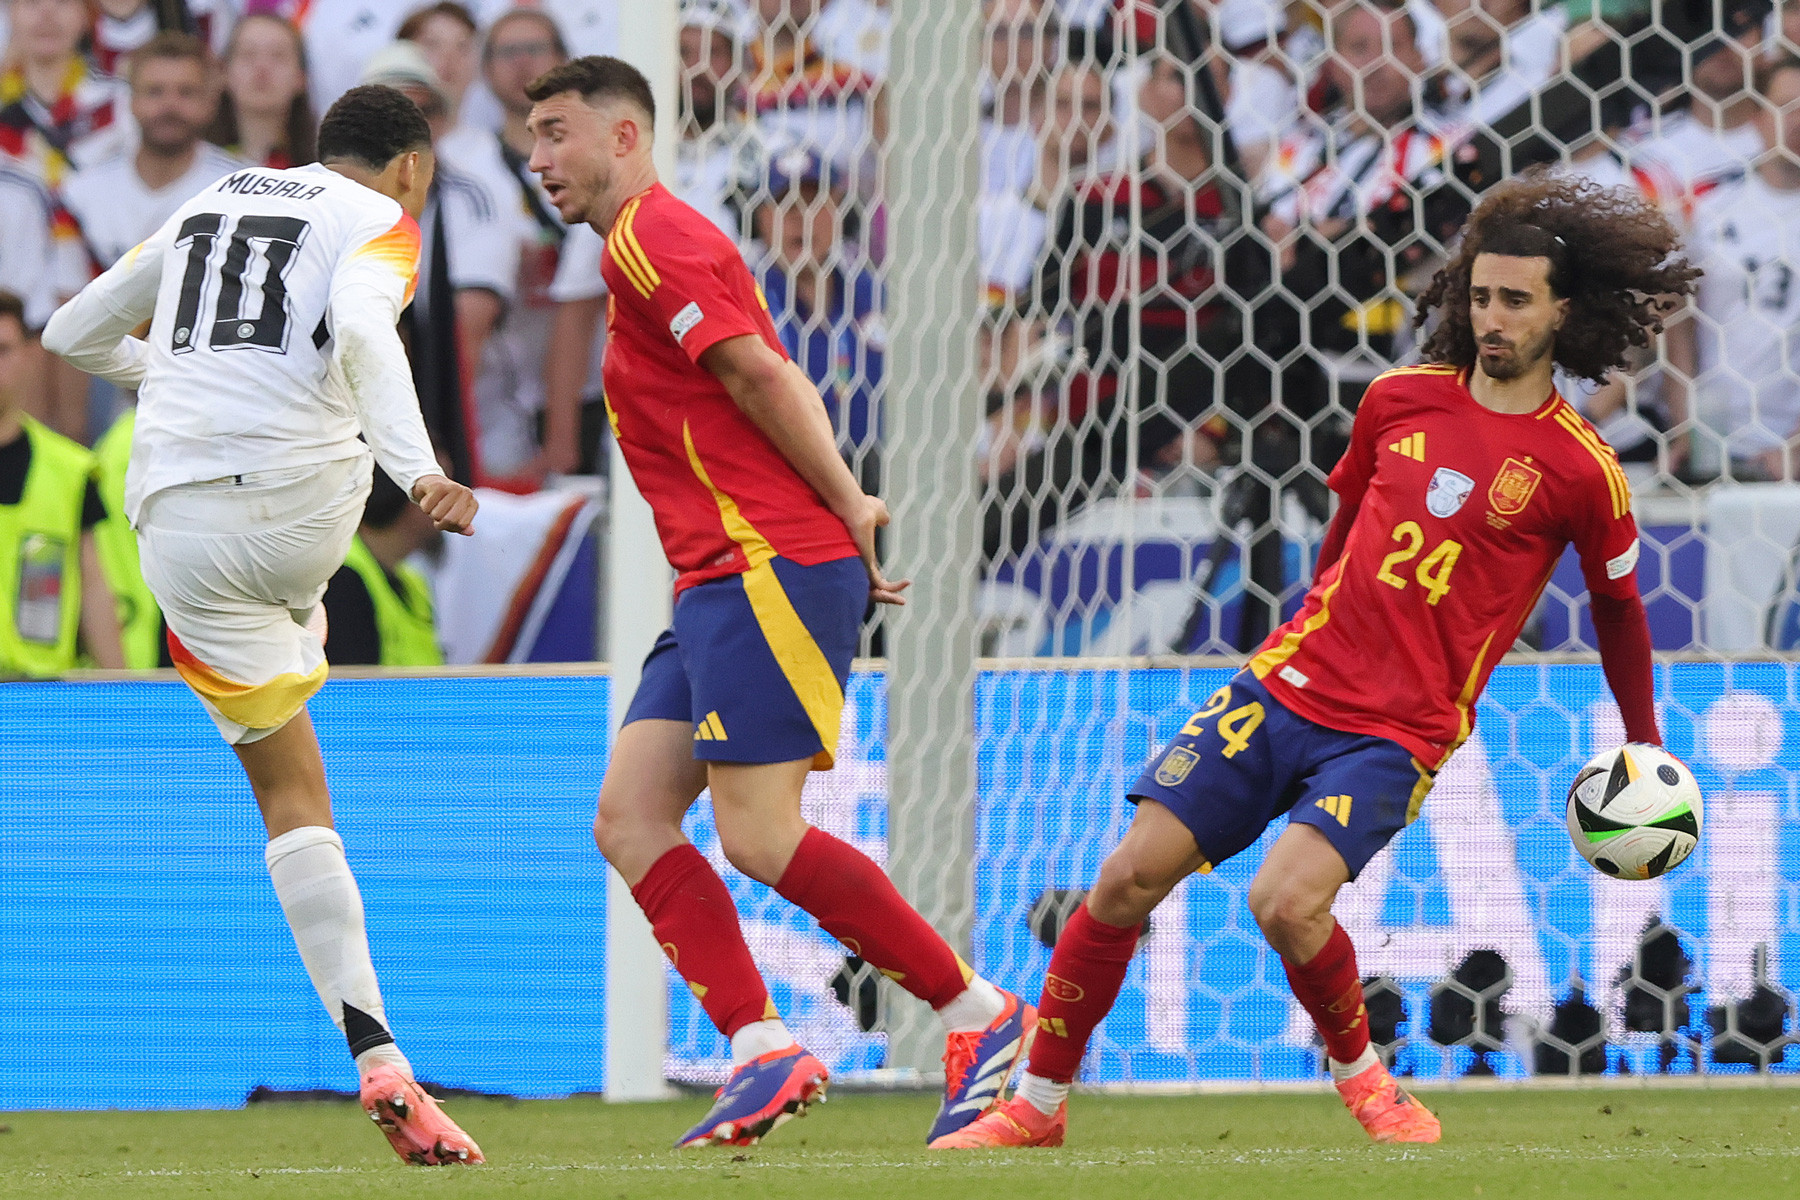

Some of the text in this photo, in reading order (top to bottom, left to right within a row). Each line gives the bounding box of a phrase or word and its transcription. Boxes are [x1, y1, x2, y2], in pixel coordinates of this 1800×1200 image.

[217, 172, 327, 201] MUSIALA
[171, 212, 312, 356] 10
[1376, 520, 1464, 607] 24
[1180, 685, 1266, 760] 24
